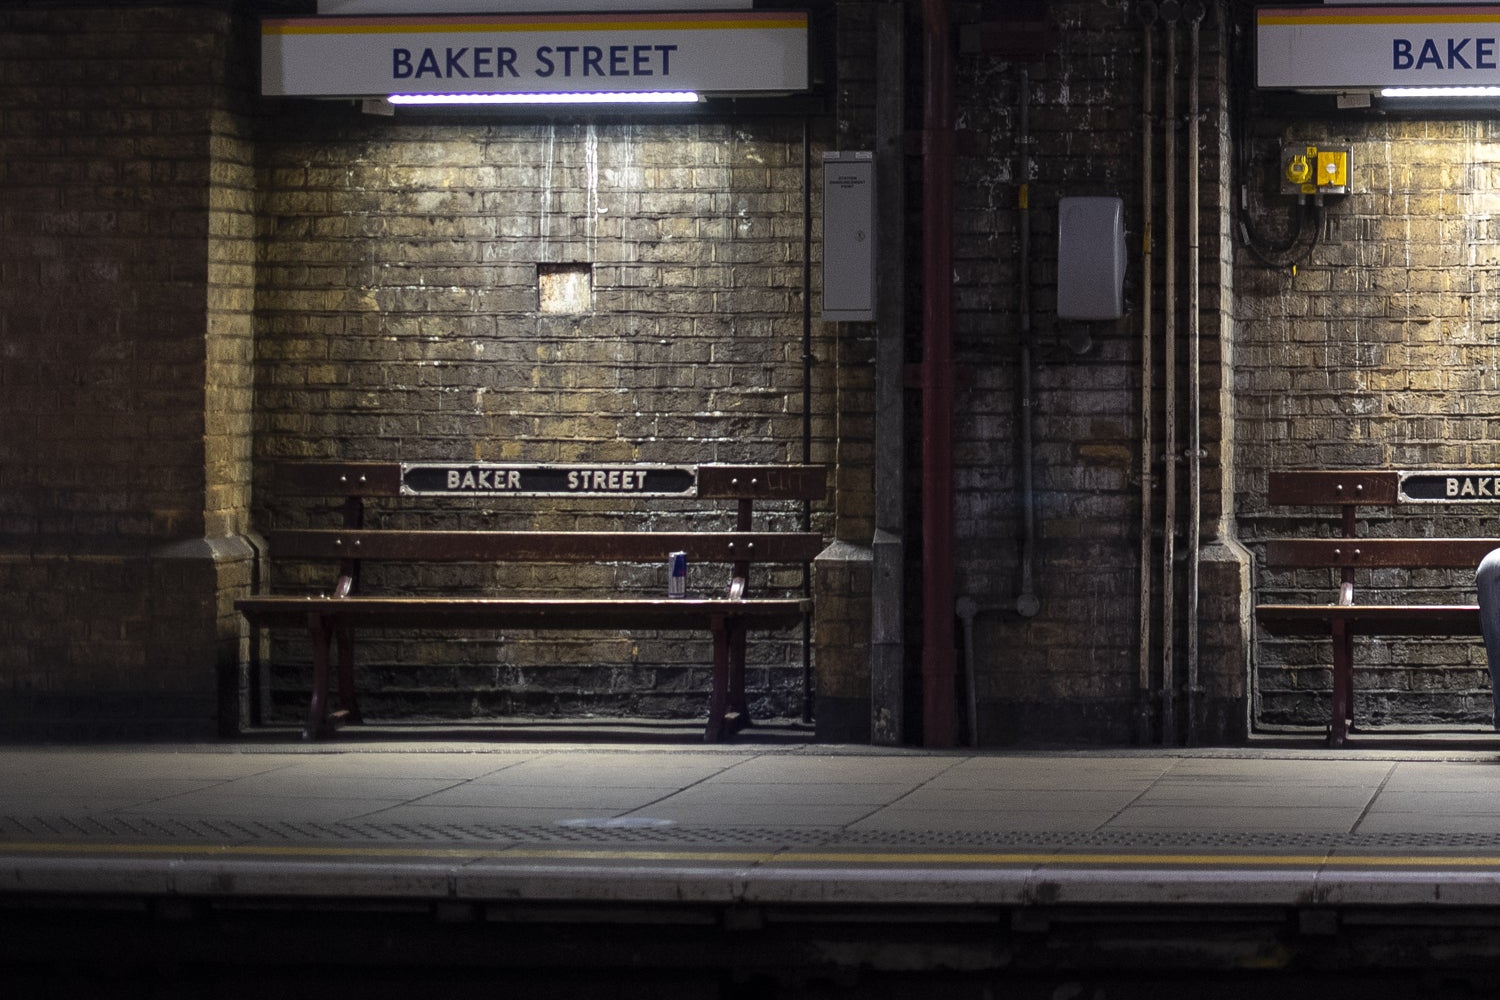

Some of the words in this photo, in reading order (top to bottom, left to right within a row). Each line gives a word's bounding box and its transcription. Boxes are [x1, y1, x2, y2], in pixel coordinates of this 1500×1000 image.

[391, 46, 520, 79] BAKER
[535, 44, 678, 78] STREET
[447, 470, 521, 489] BAKER
[567, 470, 647, 489] STREET
